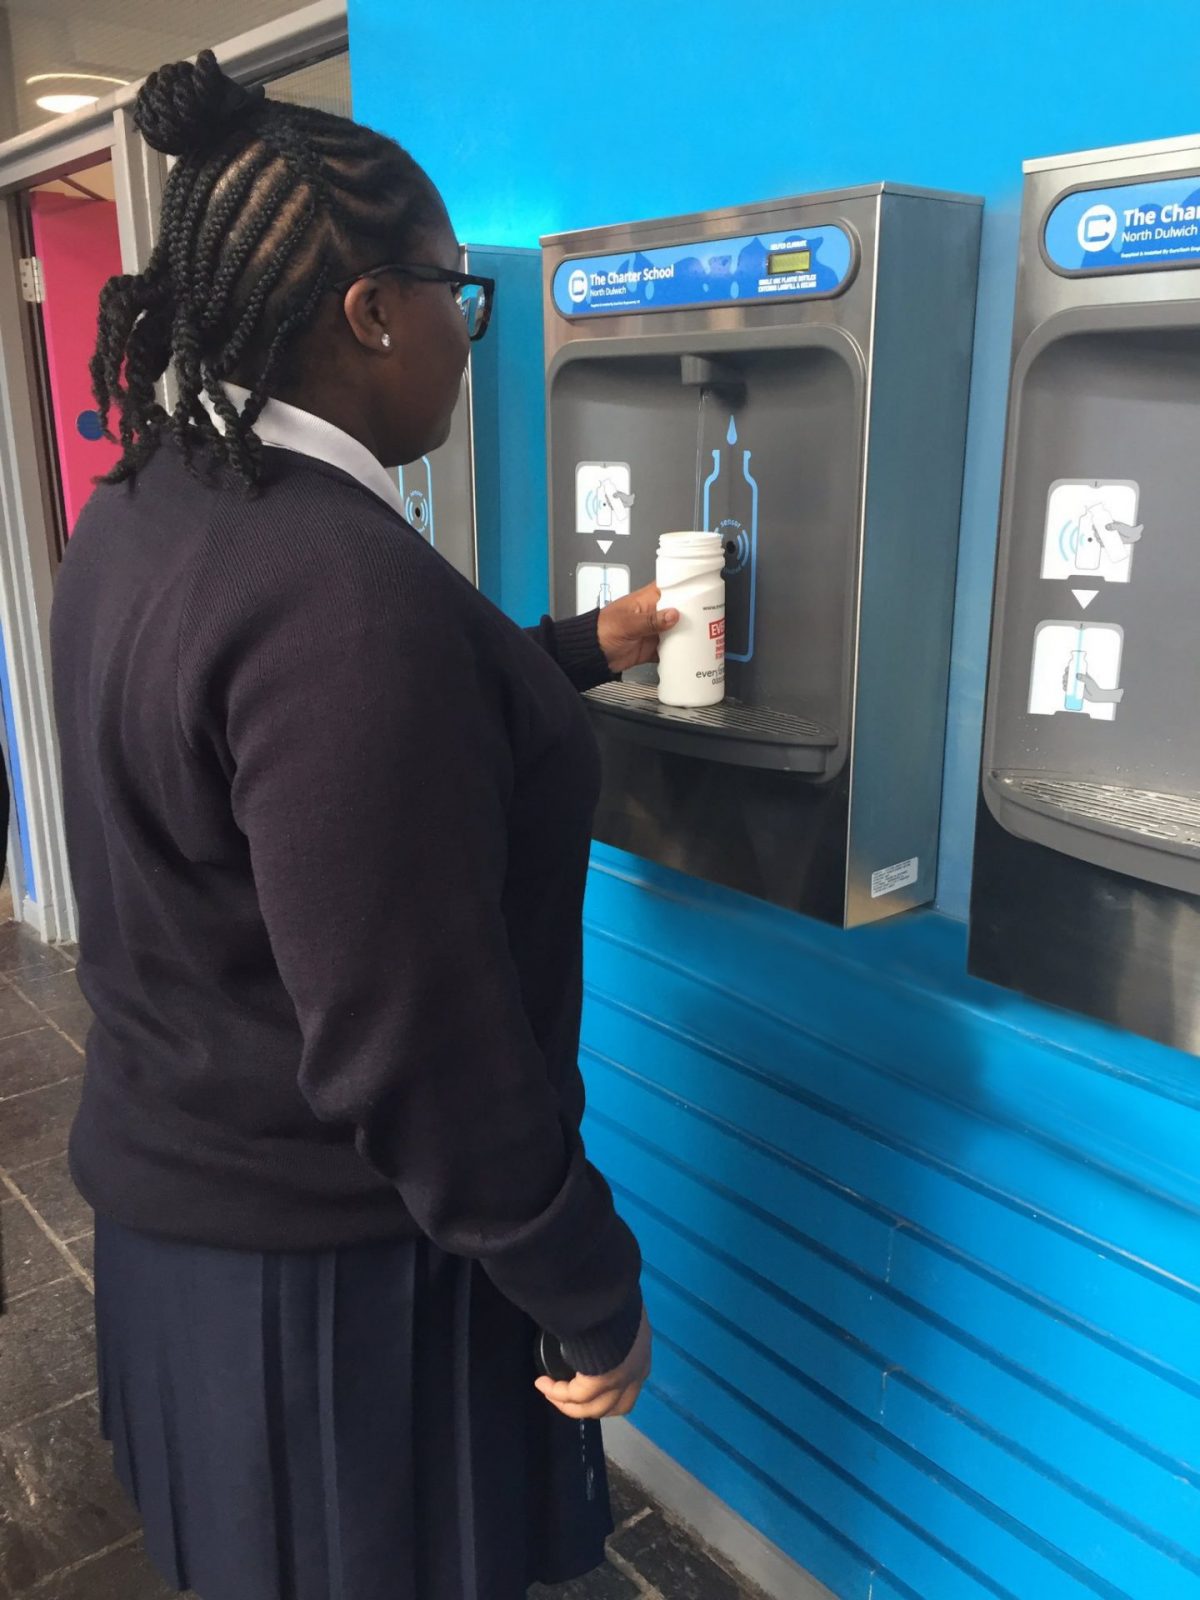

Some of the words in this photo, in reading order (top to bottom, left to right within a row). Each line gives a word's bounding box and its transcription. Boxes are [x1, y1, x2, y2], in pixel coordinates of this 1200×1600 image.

[1123, 208, 1156, 227] The
[1121, 230, 1152, 243] North
[1155, 224, 1198, 239] Dulwich
[590, 273, 606, 286] The
[607, 270, 642, 284] Charter
[643, 264, 674, 281] School
[590, 288, 606, 297] North
[606, 286, 627, 296] Dulwich
